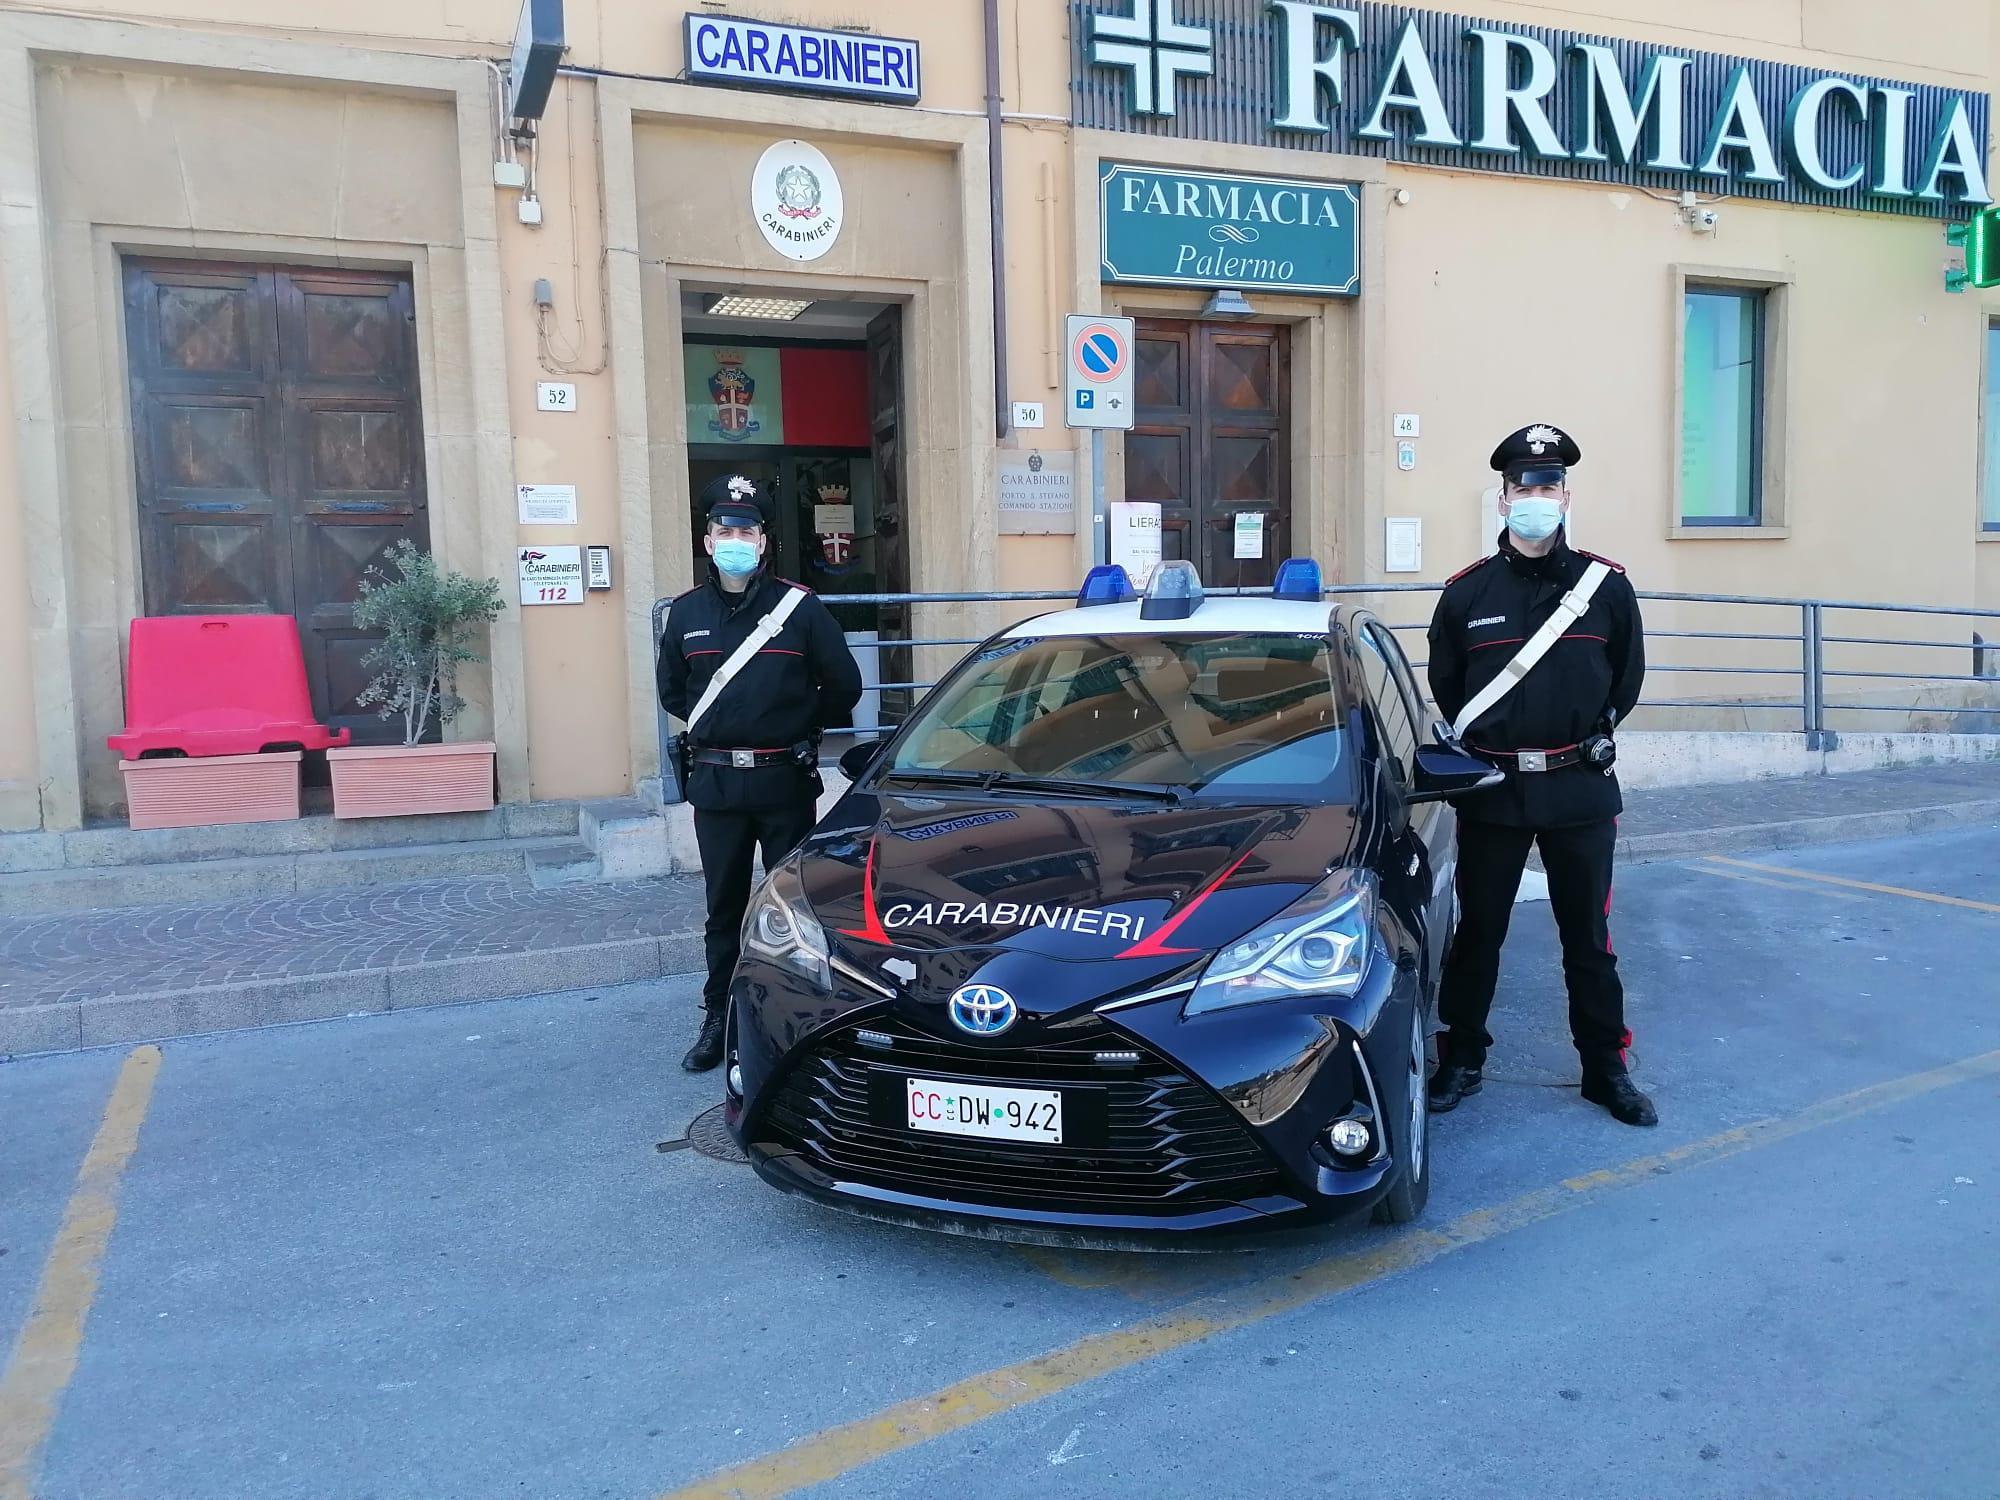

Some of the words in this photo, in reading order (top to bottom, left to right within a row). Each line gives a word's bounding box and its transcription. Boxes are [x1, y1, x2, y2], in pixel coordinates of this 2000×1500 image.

[696, 23, 914, 89] CARABINIERI
[1266, 0, 1994, 206] FARMACIA
[1121, 177, 1341, 228] FARMACIA
[762, 212, 836, 243] CARABINIERI
[1173, 244, 1295, 281] Palermo
[549, 389, 566, 404] 52
[1021, 408, 1036, 421] 50
[1400, 419, 1412, 431] 48
[1001, 474, 1069, 485] CARABINIERI
[998, 502, 1036, 510] COMANDO
[527, 564, 580, 573] CARABINIERI
[539, 588, 567, 601] 112
[1467, 615, 1506, 629] CARABINIERI
[883, 902, 1145, 942] CARABINIERI
[911, 1091, 942, 1120] CC
[959, 1095, 990, 1126] DW
[1006, 1100, 1058, 1132] 942
